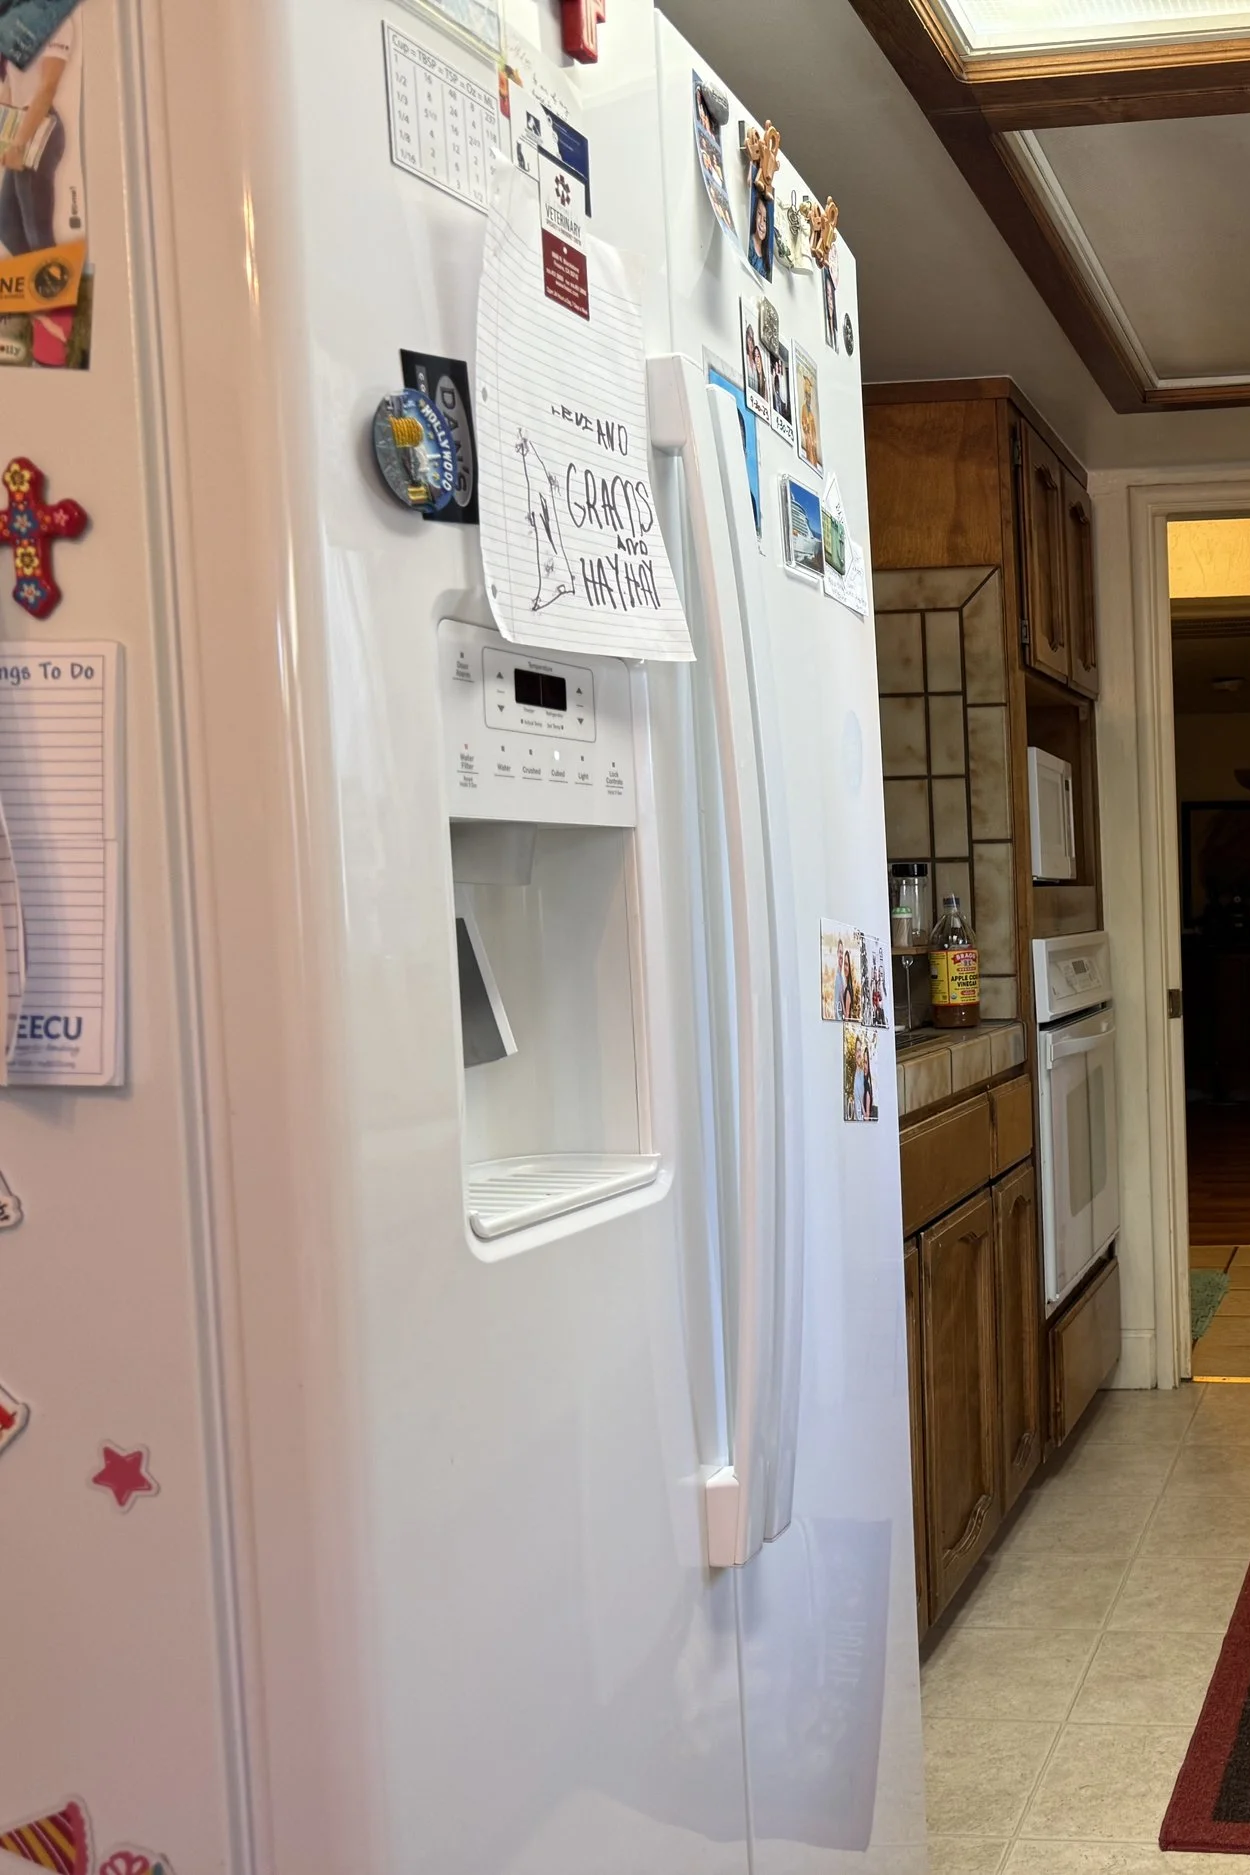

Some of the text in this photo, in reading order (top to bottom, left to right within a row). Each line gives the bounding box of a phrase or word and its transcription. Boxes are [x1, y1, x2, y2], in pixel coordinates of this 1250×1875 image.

[392, 34, 409, 53] Cup
[417, 49, 437, 69] TBSP
[545, 203, 581, 238] VETERINARY
[420, 404, 453, 491] HOLLYWOOD
[597, 419, 628, 456] AND
[567, 463, 653, 537] GRAMS
[617, 534, 648, 555] AND
[39, 661, 61, 679] To
[71, 662, 94, 679] Do
[497, 763, 511, 772] Water
[522, 766, 541, 775] Crushed
[551, 769, 565, 777] Cubed
[578, 772, 589, 781] Light
